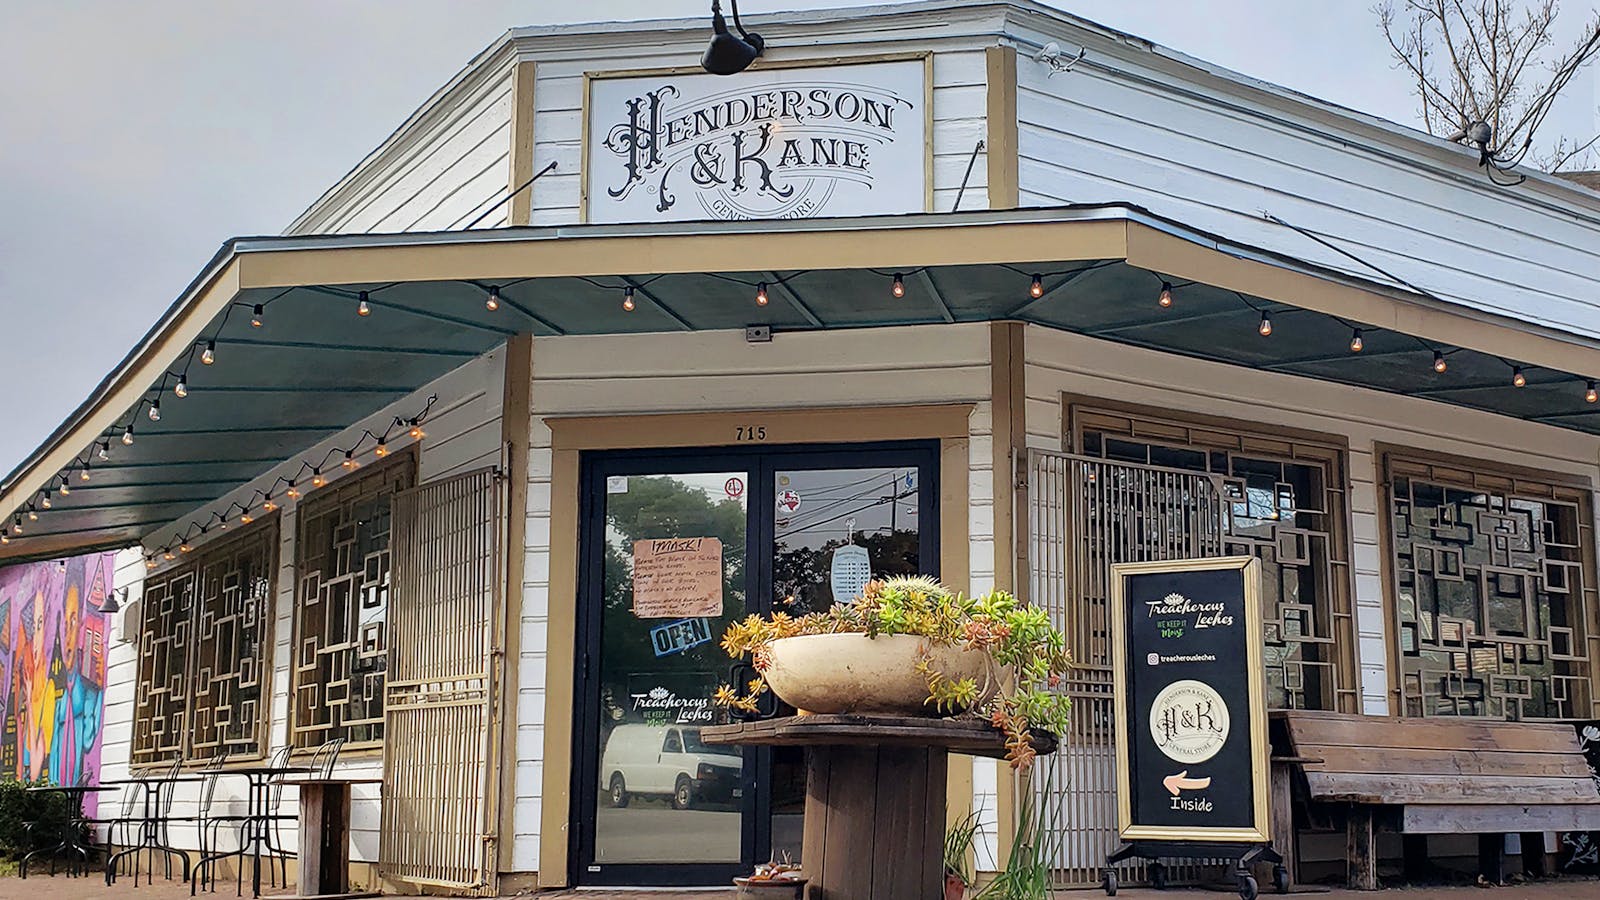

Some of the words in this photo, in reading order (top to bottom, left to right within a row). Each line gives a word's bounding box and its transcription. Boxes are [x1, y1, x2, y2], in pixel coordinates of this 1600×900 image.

[602, 86, 896, 212] HENDERSON
[691, 143, 730, 188] &
[731, 122, 873, 198] KANE
[777, 198, 815, 220] TORE
[736, 426, 766, 441] 715
[1145, 599, 1225, 618] Treacherous
[1166, 620, 1180, 628] KEEP
[1194, 611, 1233, 629] Leches
[655, 619, 708, 652] OPEN
[1160, 653, 1216, 663] treacherousleches
[631, 693, 708, 712] Treacherous
[676, 706, 713, 724] Leches
[1170, 796, 1213, 812] Inside
